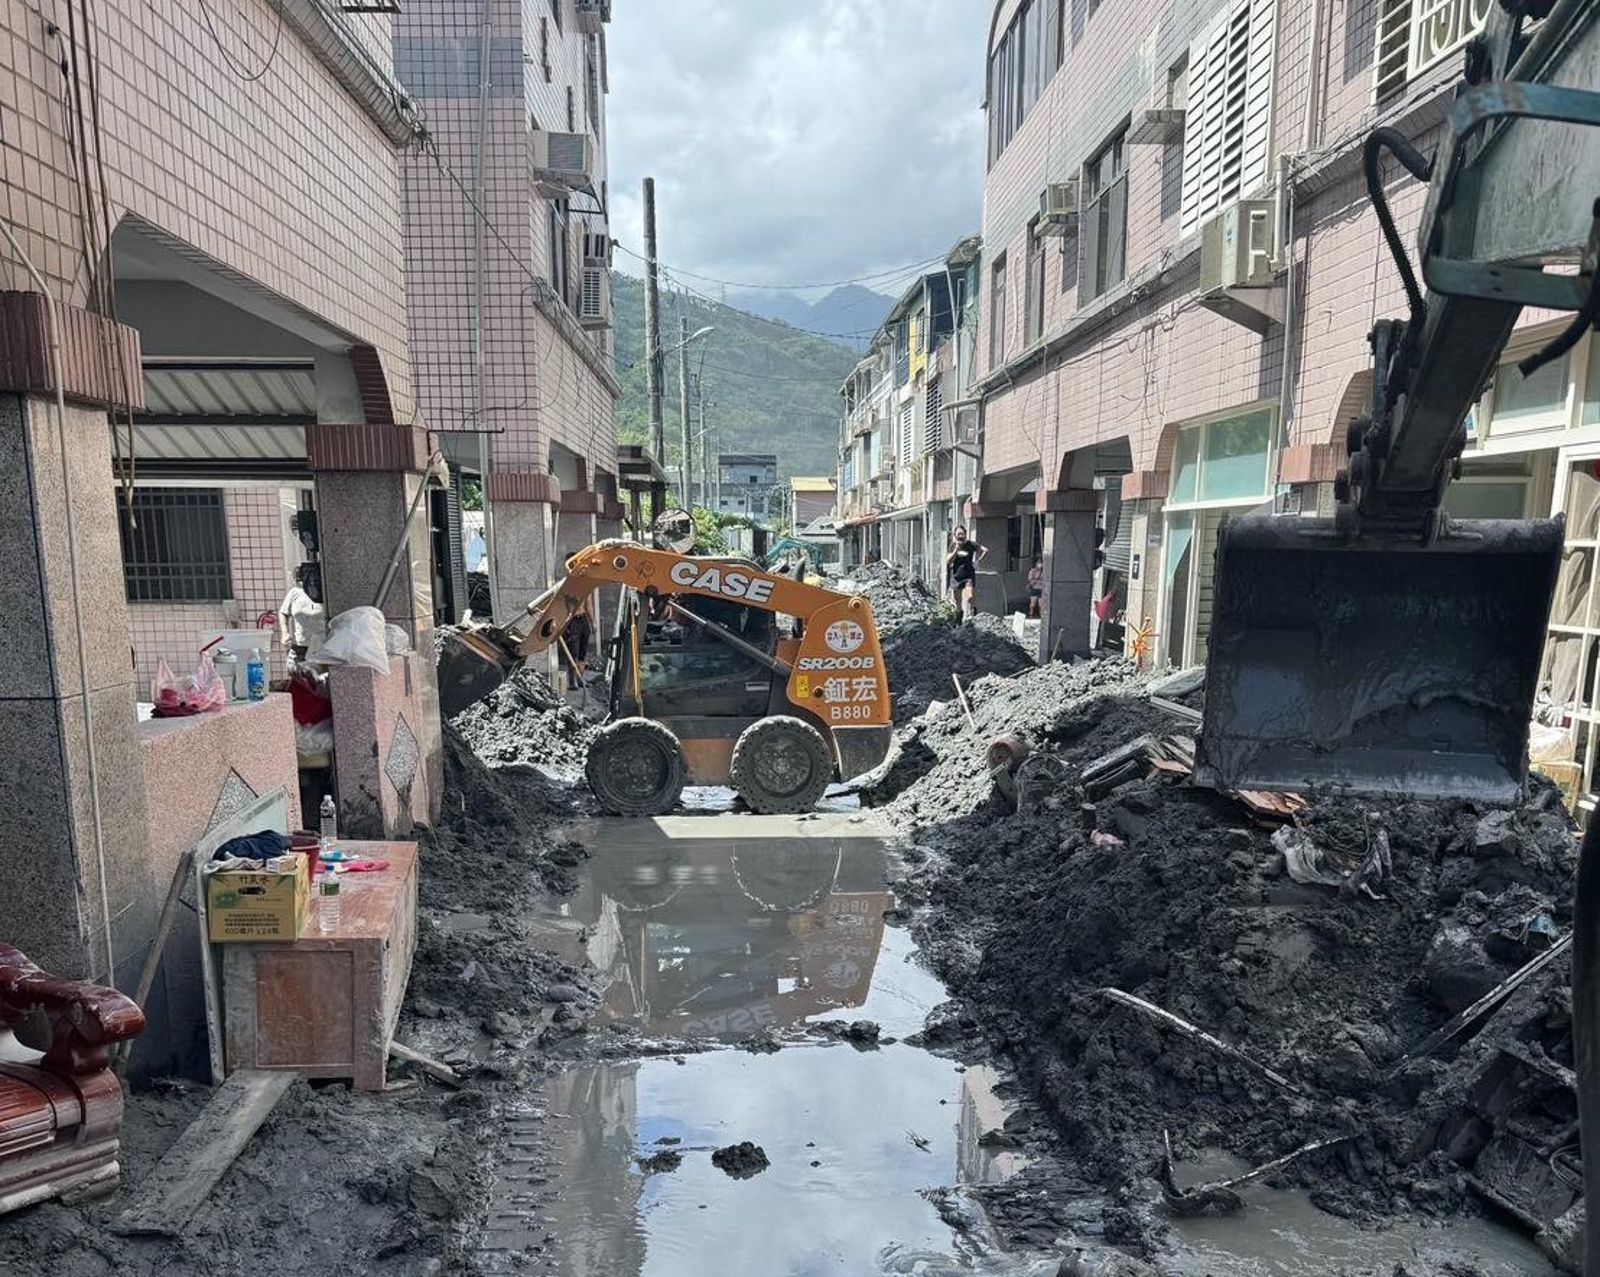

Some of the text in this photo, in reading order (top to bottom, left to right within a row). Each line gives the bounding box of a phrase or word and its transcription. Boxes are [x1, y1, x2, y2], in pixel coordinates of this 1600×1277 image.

[670, 561, 775, 602] CASE
[798, 657, 875, 671] SR200B
[831, 705, 871, 719] B880
